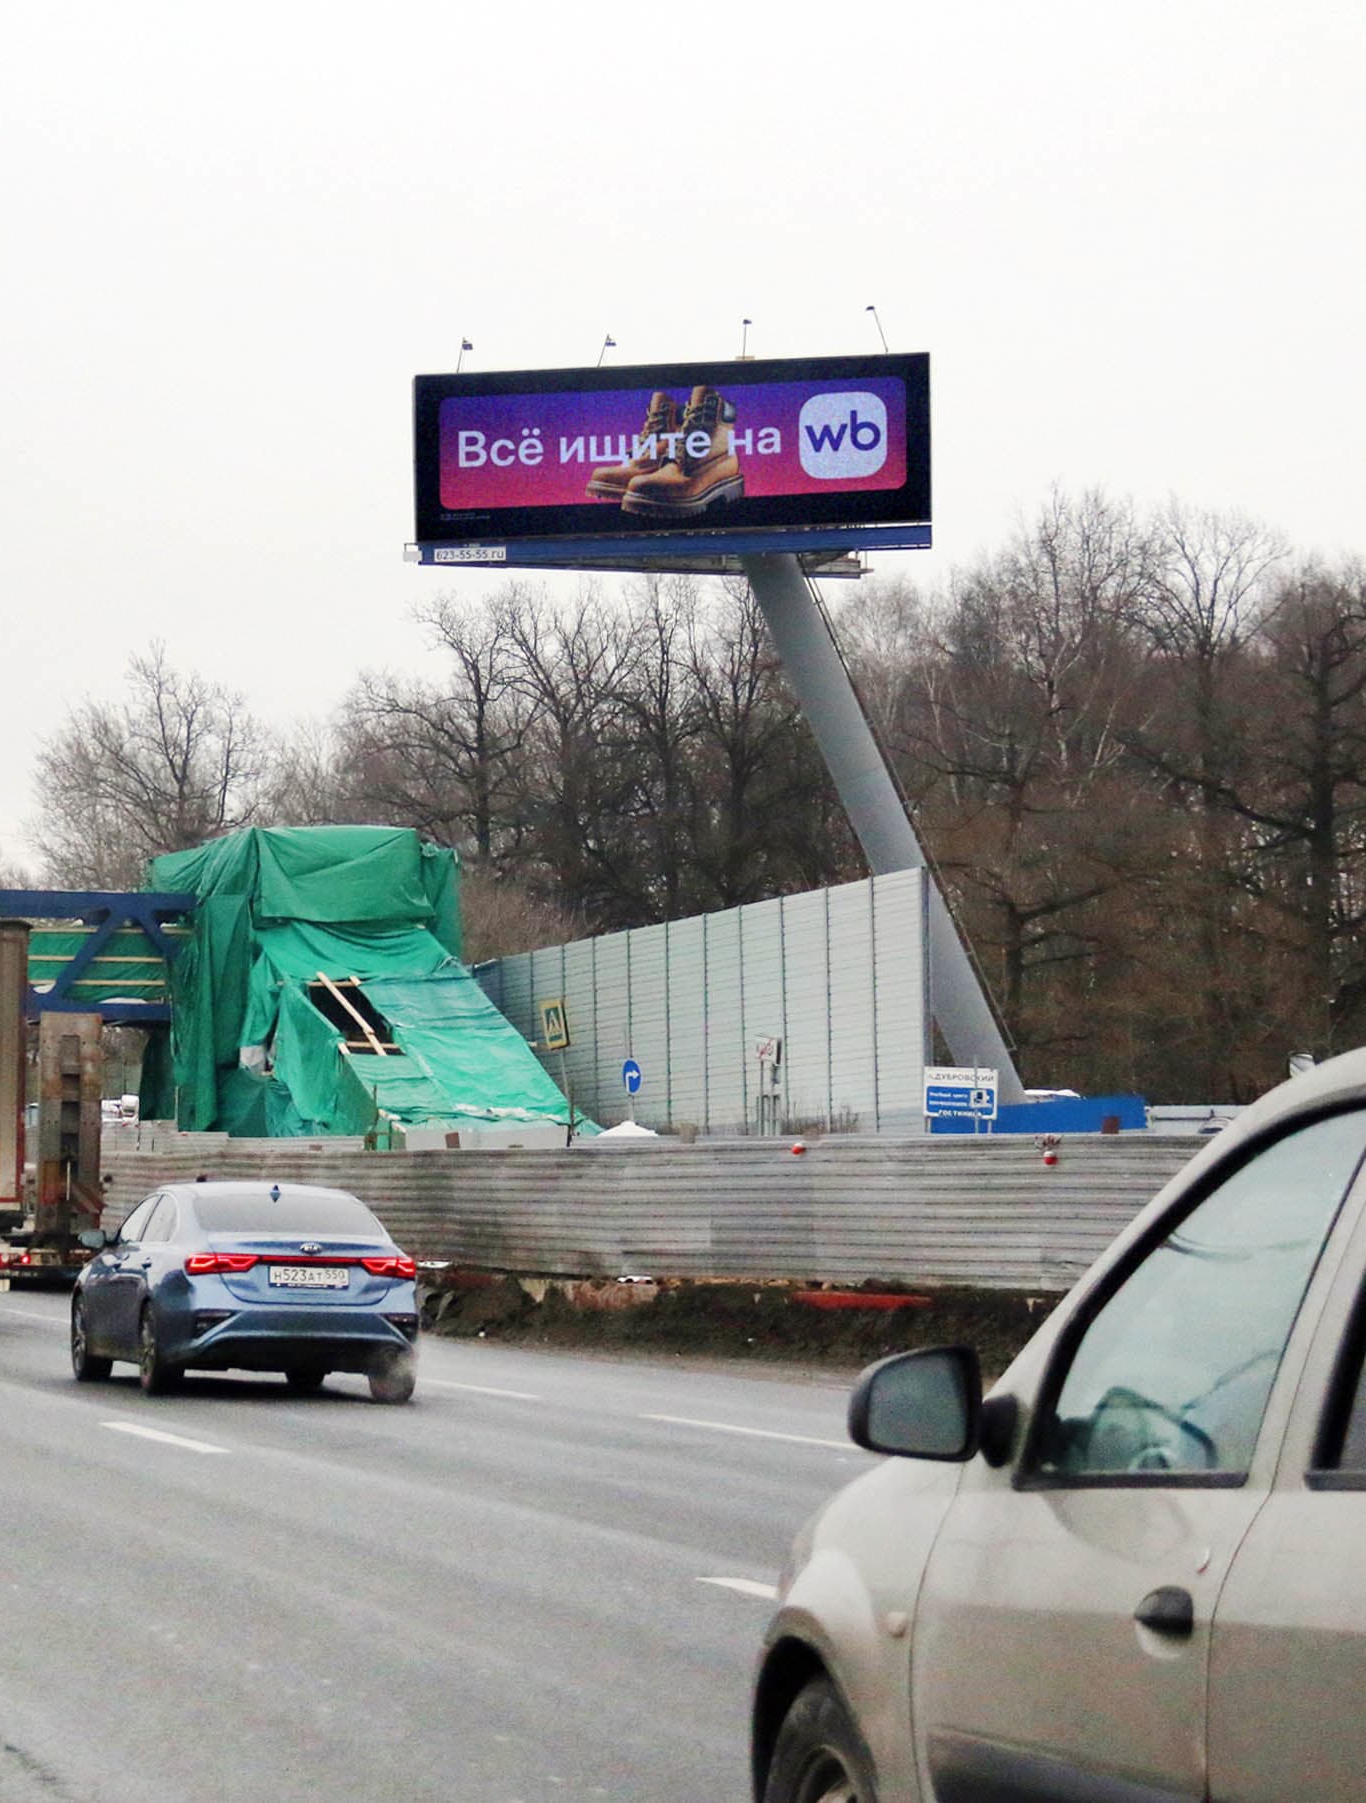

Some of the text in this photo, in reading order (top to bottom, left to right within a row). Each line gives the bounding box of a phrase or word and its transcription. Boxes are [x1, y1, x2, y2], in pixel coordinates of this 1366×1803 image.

[458, 426, 782, 468] Всё ищите на
[805, 410, 882, 453] wb
